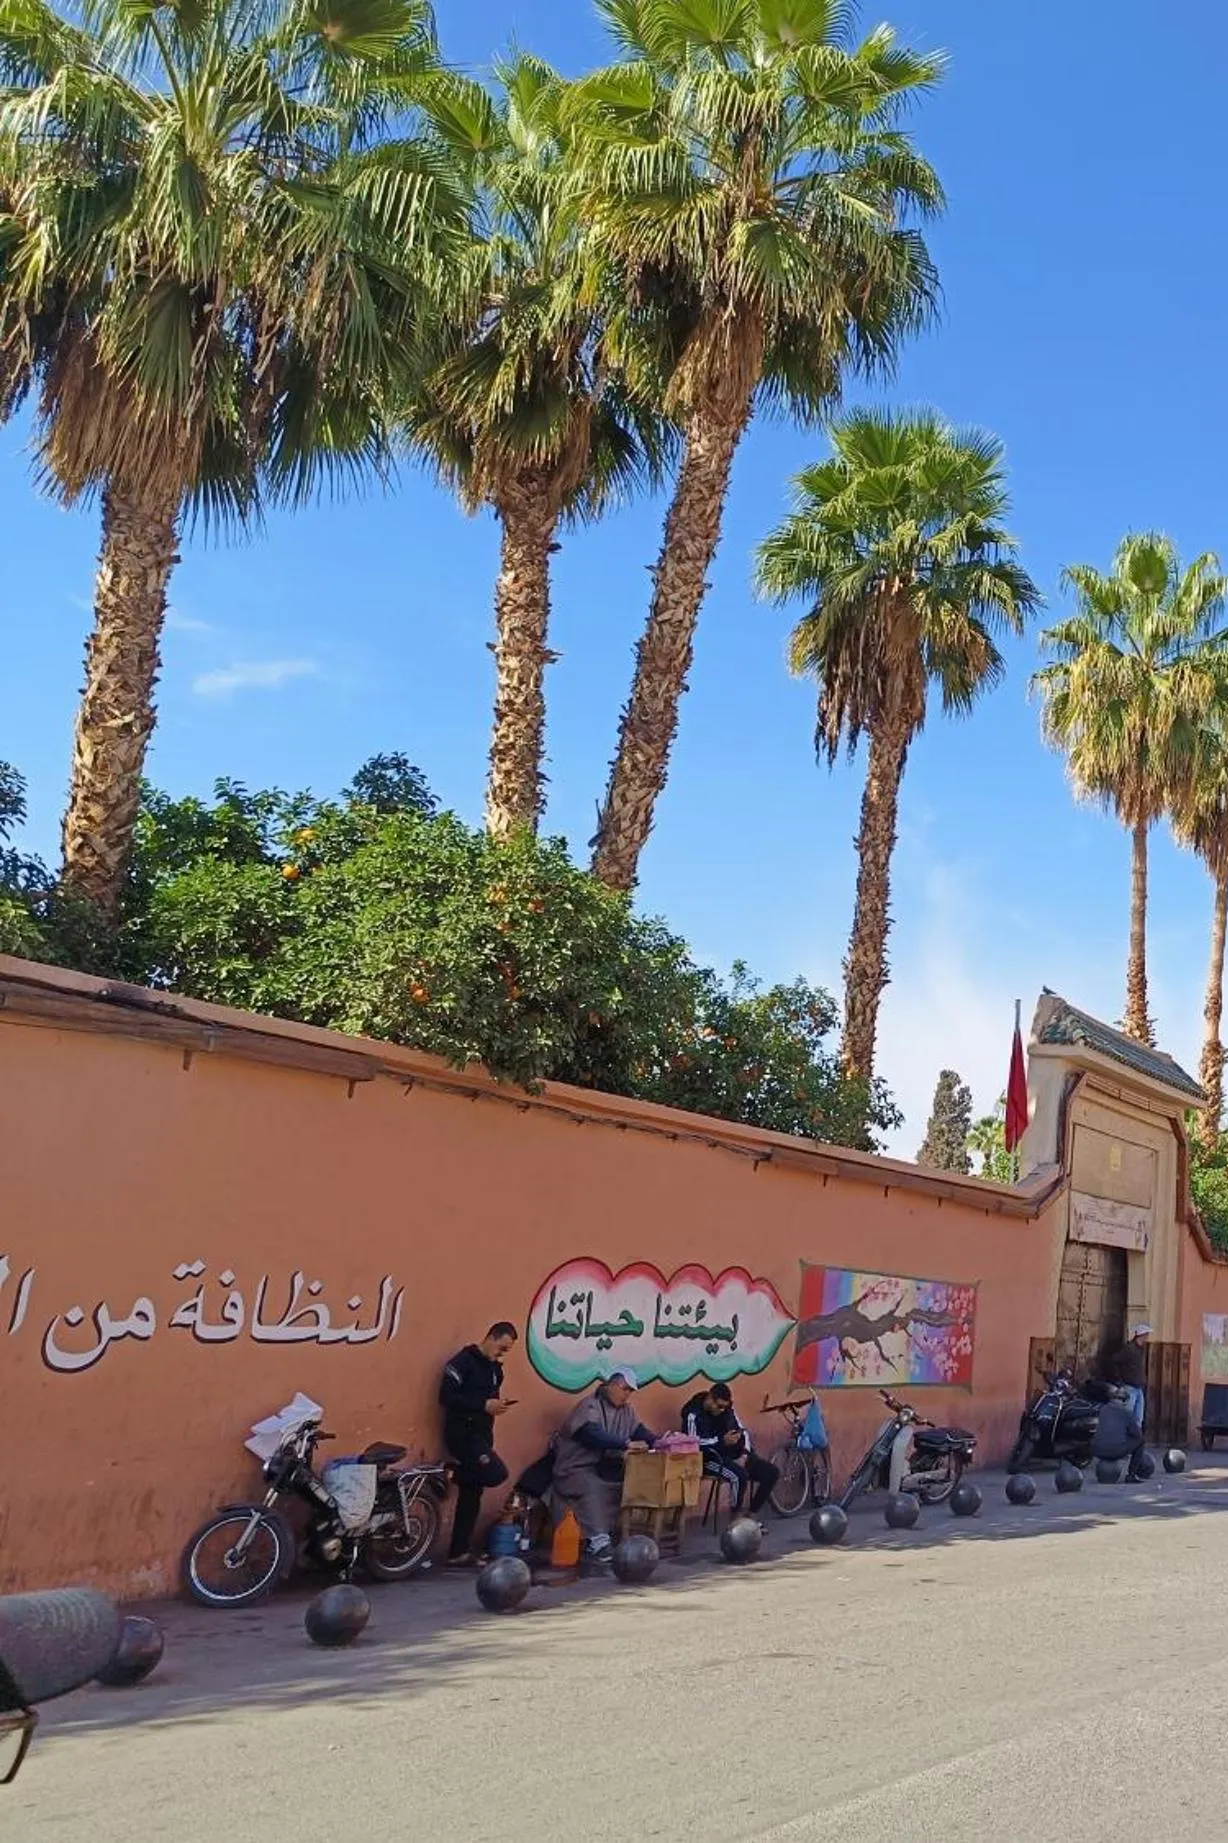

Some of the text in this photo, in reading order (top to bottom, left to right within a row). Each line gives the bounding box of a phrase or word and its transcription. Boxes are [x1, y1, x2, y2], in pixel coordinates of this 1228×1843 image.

[40, 1259, 405, 1373] النظافة من
[545, 1284, 740, 1355] بيئتنا حياتنا
